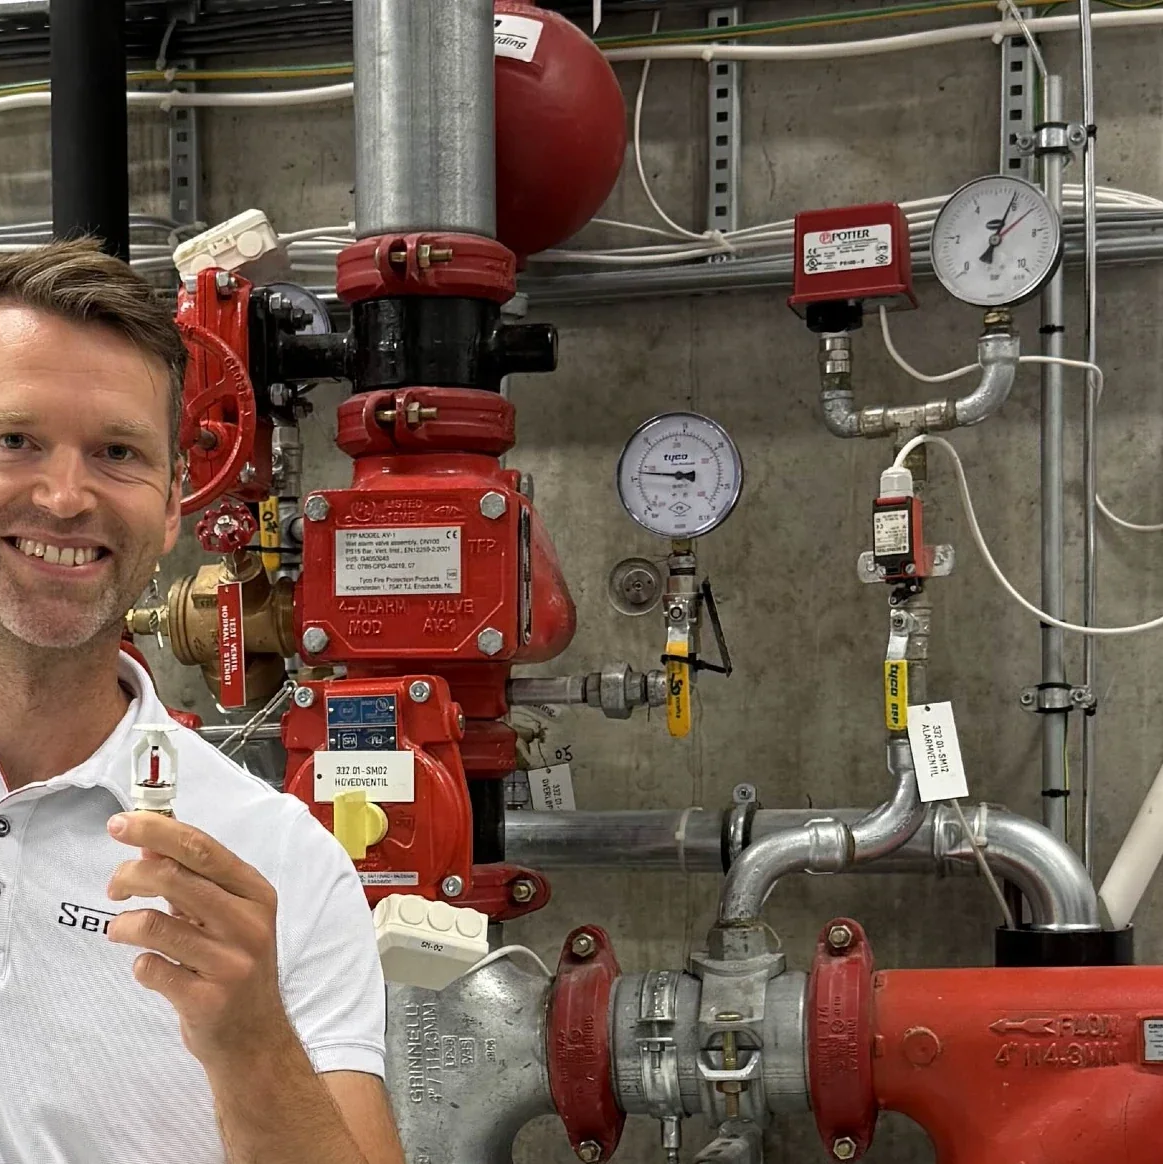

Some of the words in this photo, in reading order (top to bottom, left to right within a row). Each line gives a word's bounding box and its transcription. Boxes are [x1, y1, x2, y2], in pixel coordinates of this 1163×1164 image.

[974, 206, 980, 215] 4
[832, 229, 869, 242] POTTER
[956, 235, 960, 244] 2
[1032, 228, 1037, 238] 8
[964, 261, 970, 271] 0
[1017, 258, 1026, 268] 10
[664, 454, 688, 462] tyco
[428, 599, 474, 614] VALVE
[222, 605, 230, 647] NORMALT
[348, 620, 382, 634] MOD
[888, 664, 898, 696] tyco
[556, 744, 573, 761] 05
[922, 724, 939, 777] ALARMVENTIL
[335, 778, 388, 786] HOVEDVENTIL
[1058, 1014, 1121, 1037] FLOW
[404, 1002, 425, 1103] GRINNELL
